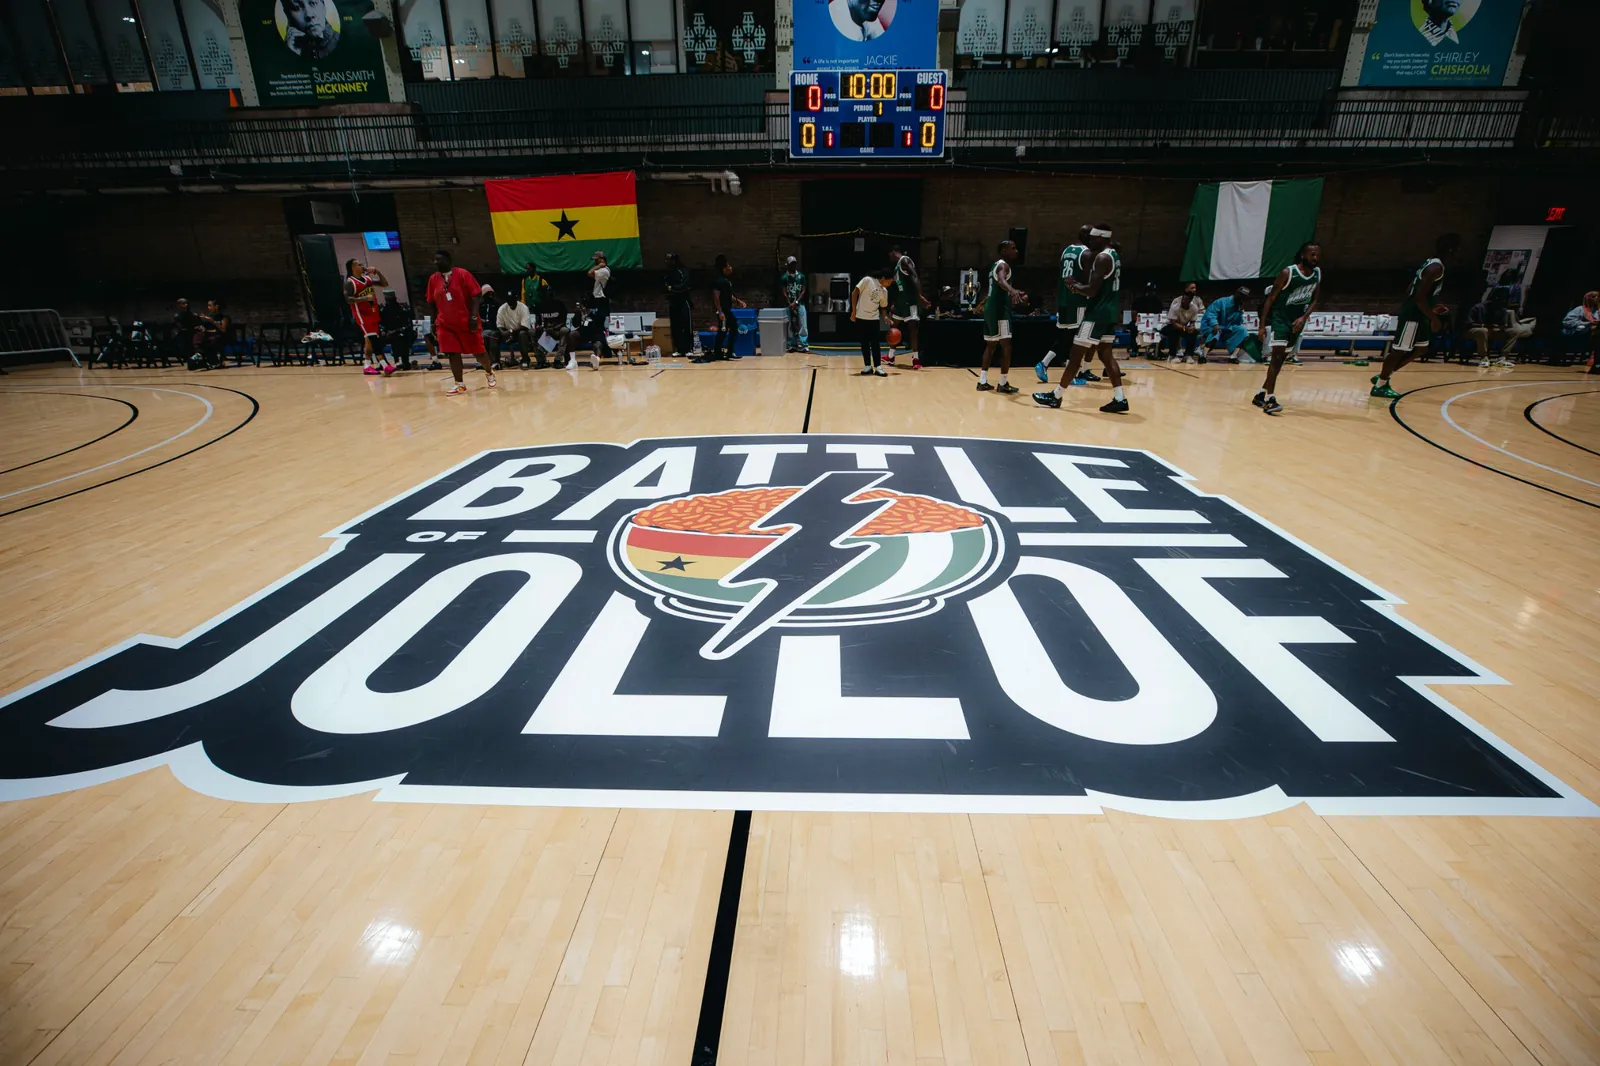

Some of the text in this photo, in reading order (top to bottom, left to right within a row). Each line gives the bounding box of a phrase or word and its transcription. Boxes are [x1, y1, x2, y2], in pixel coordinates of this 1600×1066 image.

[864, 55, 898, 66] JACKIE
[1434, 52, 1480, 63] SHIRLEY
[313, 70, 376, 83] SUSAN SMITH
[1432, 64, 1491, 75] CHISHOLM
[795, 73, 819, 85] HOME
[917, 72, 943, 84] GUEST
[316, 82, 369, 94] MCKINNEY
[849, 73, 896, 99] 10:00
[808, 86, 821, 110] 0
[930, 85, 944, 110] 0
[803, 123, 816, 148] 0
[828, 132, 833, 146] 1
[906, 132, 912, 146] 1
[922, 122, 936, 147] 0
[1062, 259, 1074, 279] 26
[405, 444, 1212, 524] BATTLE
[405, 530, 487, 543] OF
[44, 552, 1398, 745] JOLLOF
